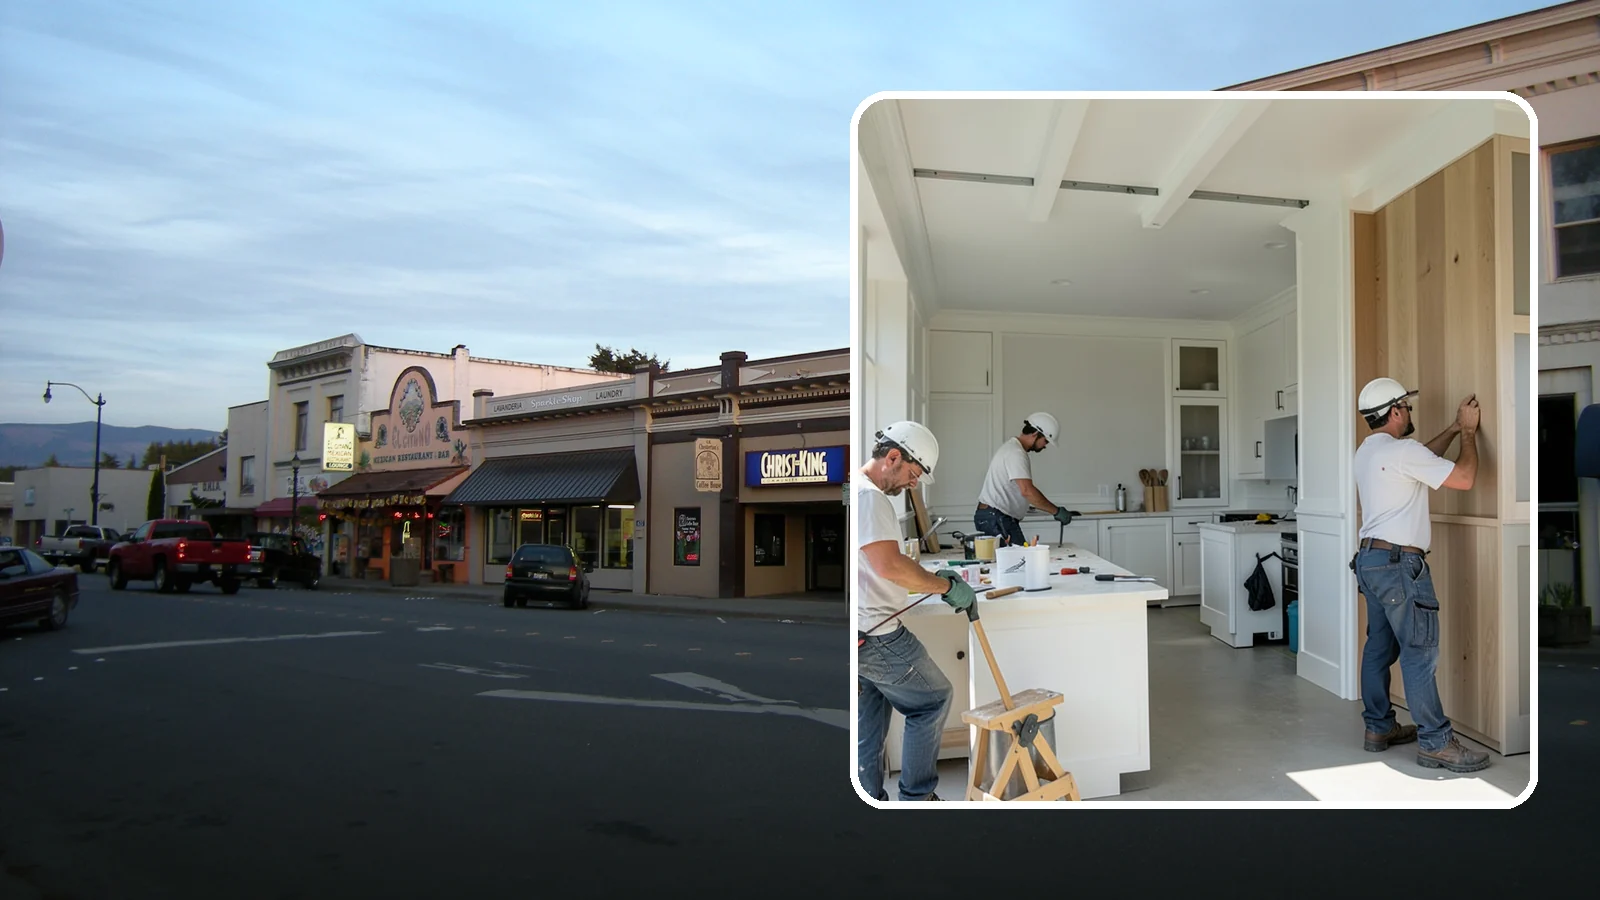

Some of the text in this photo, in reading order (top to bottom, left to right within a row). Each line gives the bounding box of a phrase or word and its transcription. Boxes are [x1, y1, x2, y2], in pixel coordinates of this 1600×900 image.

[561, 394, 583, 405] Shop
[595, 388, 624, 400] LAUNDRY
[493, 401, 522, 413] LAVANDERIA
[374, 454, 396, 464] MEXICAN
[397, 451, 433, 462] RESTAURANT
[438, 450, 450, 459] BAR
[761, 450, 828, 478] CHRIST KING
